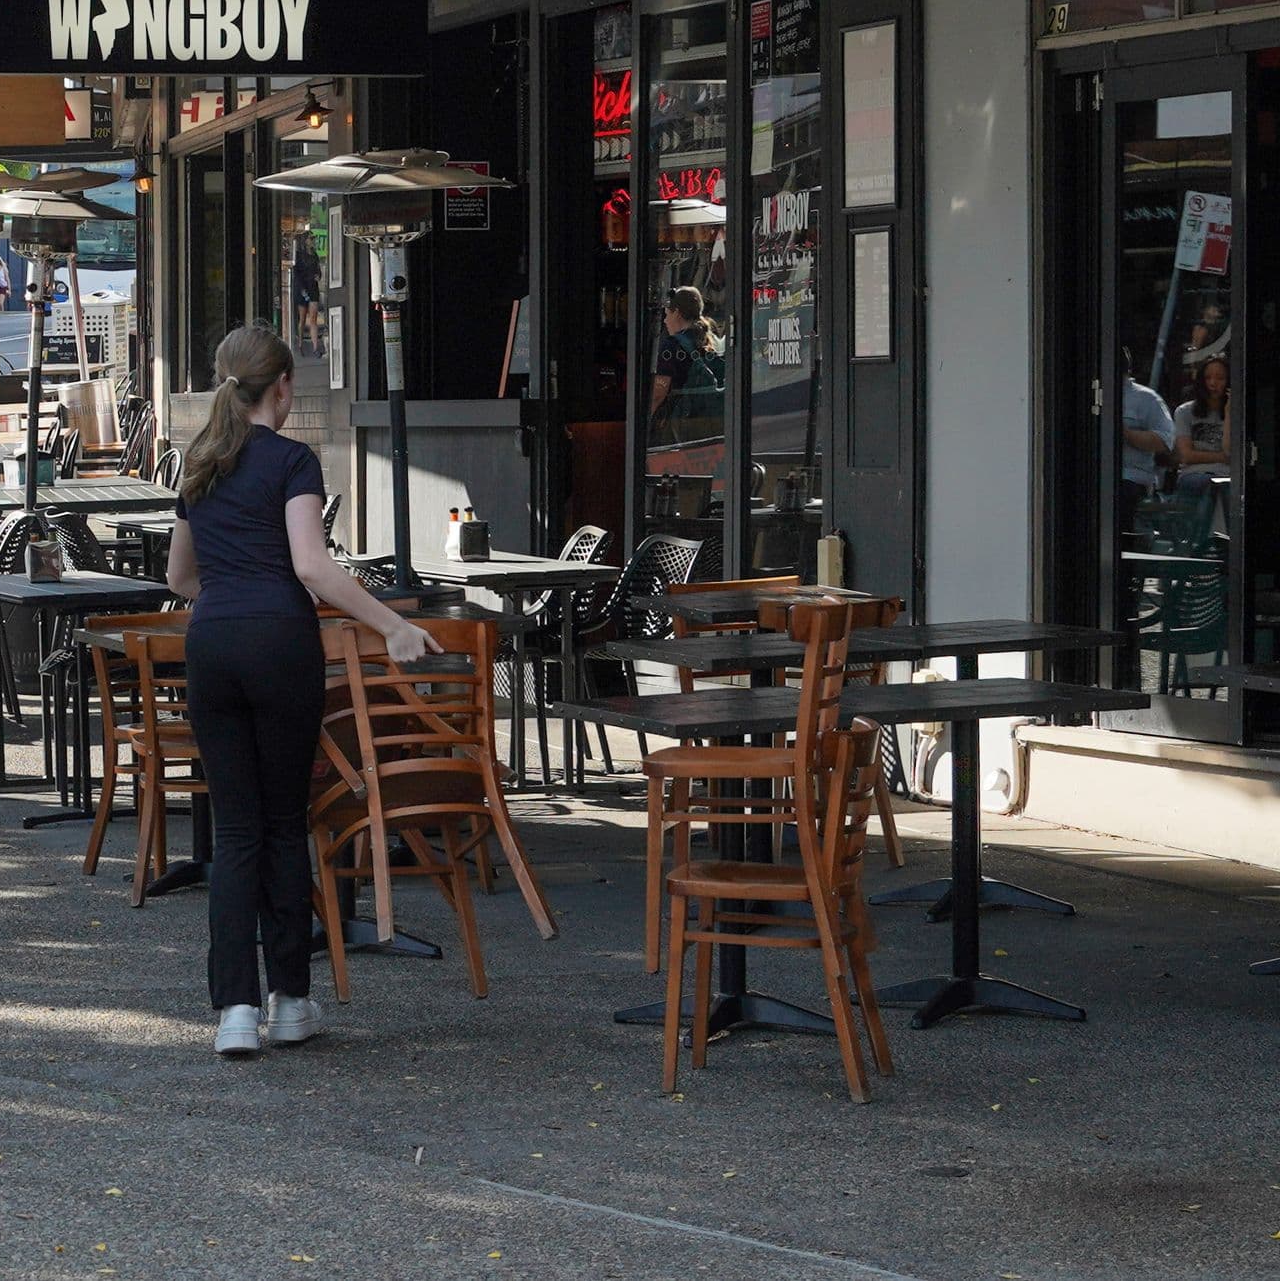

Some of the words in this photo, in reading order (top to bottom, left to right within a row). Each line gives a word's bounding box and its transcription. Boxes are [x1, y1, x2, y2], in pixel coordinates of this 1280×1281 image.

[1048, 6, 1066, 33] 29
[768, 318, 781, 341] HOT
[768, 342, 784, 365] COLD
